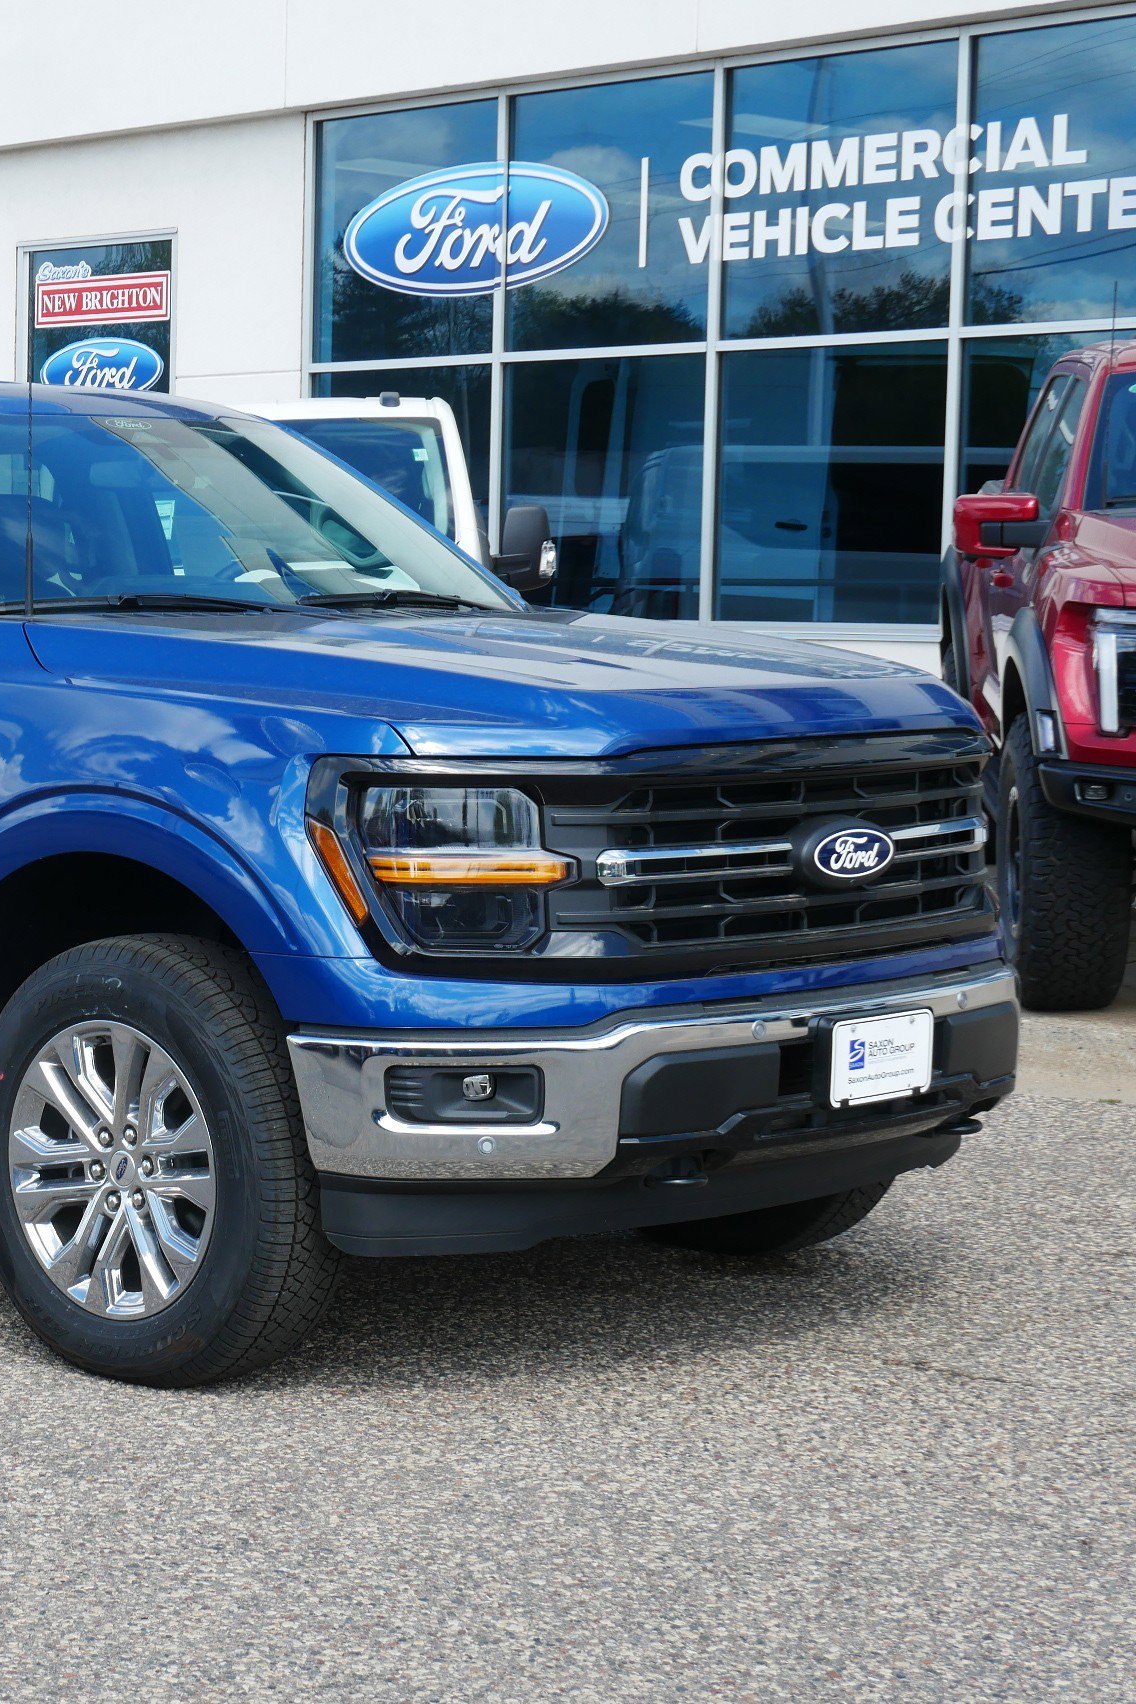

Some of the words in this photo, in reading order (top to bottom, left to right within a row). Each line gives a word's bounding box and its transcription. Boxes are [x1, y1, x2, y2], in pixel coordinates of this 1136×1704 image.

[678, 113, 1088, 202] COMMERCIAL
[394, 185, 552, 274] Ford
[677, 196, 920, 265] VEHICLE
[933, 176, 1136, 243] CENTE
[37, 262, 91, 282] Saxon's
[42, 292, 79, 314] NEW
[81, 286, 162, 311] BRIGHTON
[64, 347, 139, 389] Ford
[830, 836, 880, 870] Ford
[867, 1047, 888, 1058] AUTO
[889, 1043, 915, 1055] GROUP
[868, 1038, 895, 1050] SAXON
[847, 1068, 915, 1085] SaxonAutoGroup.com
